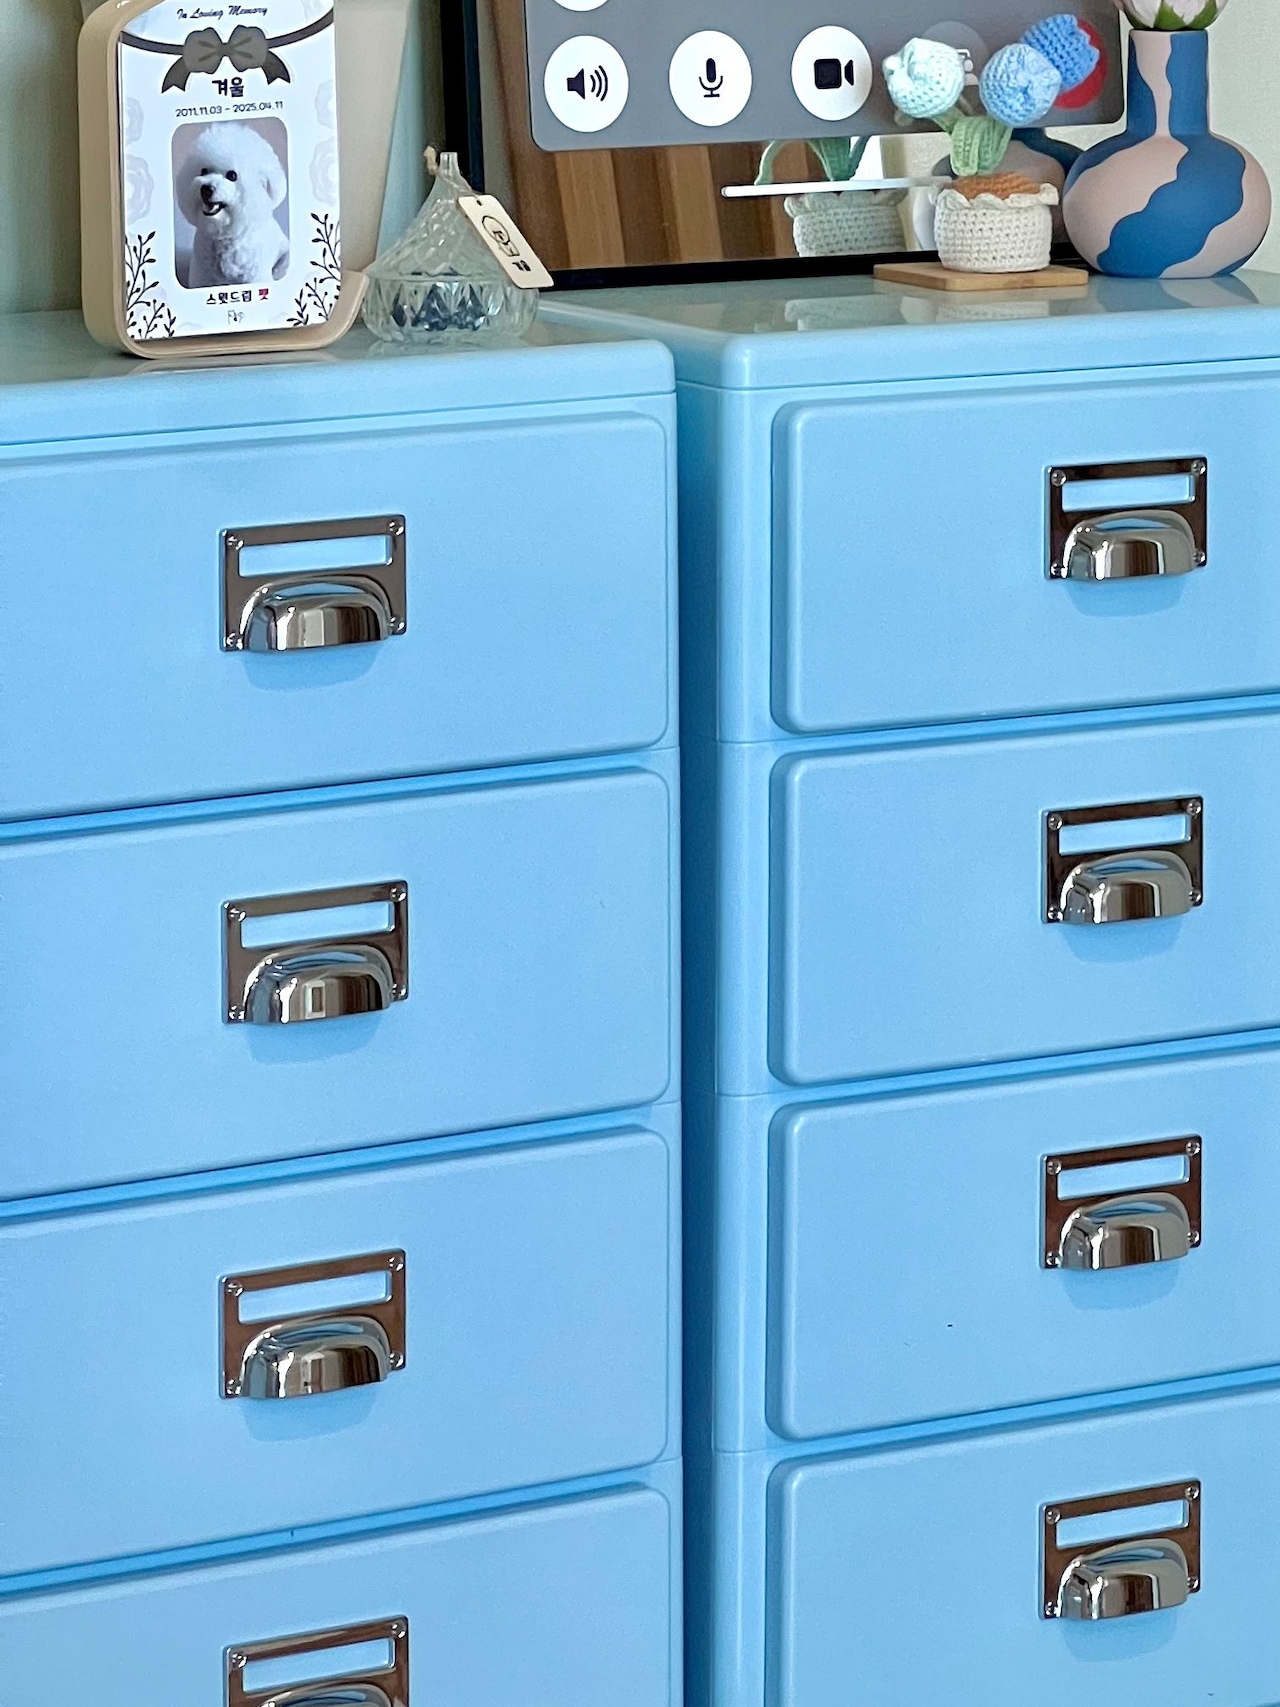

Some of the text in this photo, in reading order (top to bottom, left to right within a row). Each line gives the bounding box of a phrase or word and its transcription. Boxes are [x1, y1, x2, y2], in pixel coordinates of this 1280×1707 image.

[189, 7, 224, 20] Loving
[228, 5, 268, 16] Memory
[211, 76, 245, 98] 겨울
